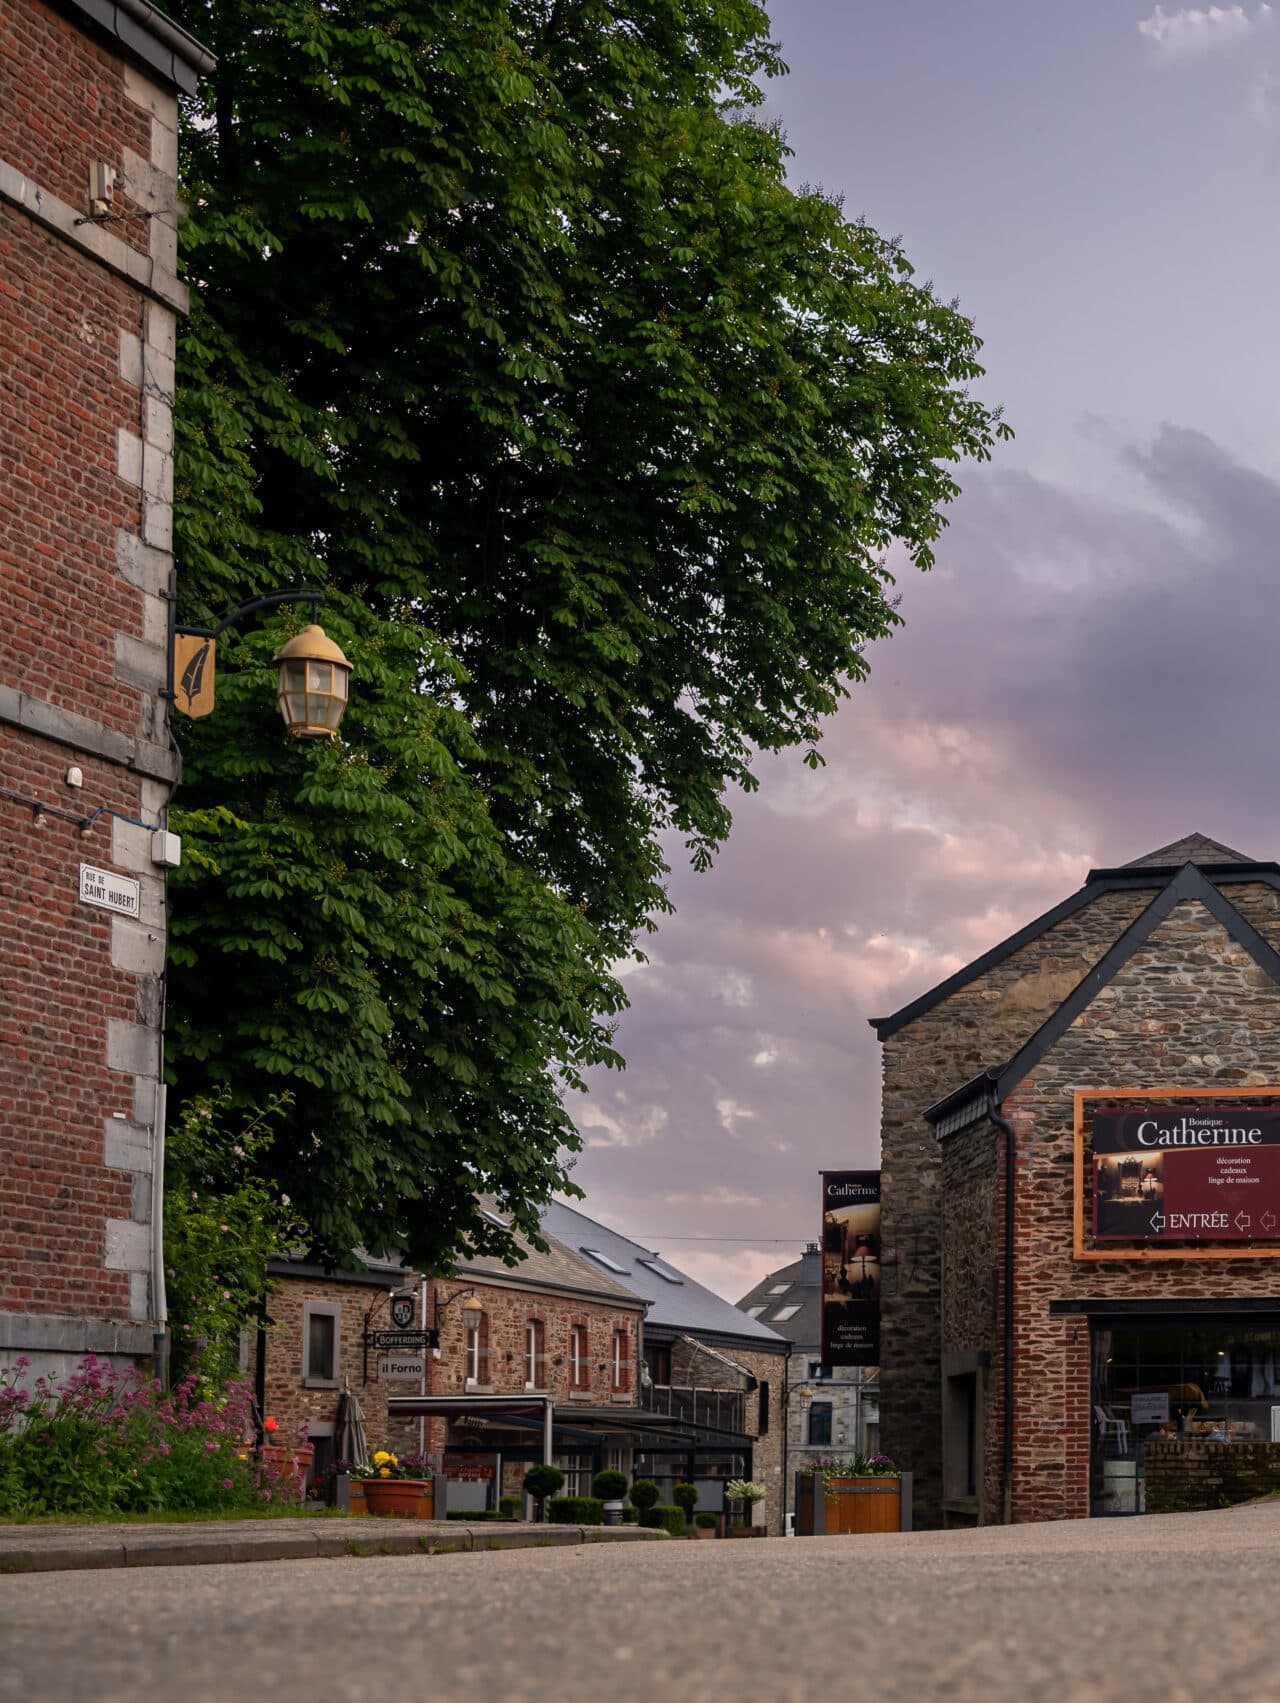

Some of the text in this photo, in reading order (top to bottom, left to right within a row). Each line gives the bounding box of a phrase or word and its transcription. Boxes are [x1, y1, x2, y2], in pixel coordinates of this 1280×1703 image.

[85, 871, 105, 885] RUE DE
[84, 883, 135, 909] SAINT HUBERT
[1189, 1117, 1223, 1127] Boutique
[1137, 1118, 1262, 1146] Catherine
[1216, 1156, 1251, 1165] décoration
[1208, 1176, 1260, 1186] linge de maison
[1170, 1210, 1229, 1229] ENTRÉE
[380, 1335, 426, 1345] BOFFERDING
[382, 1363, 422, 1373] il Forno
